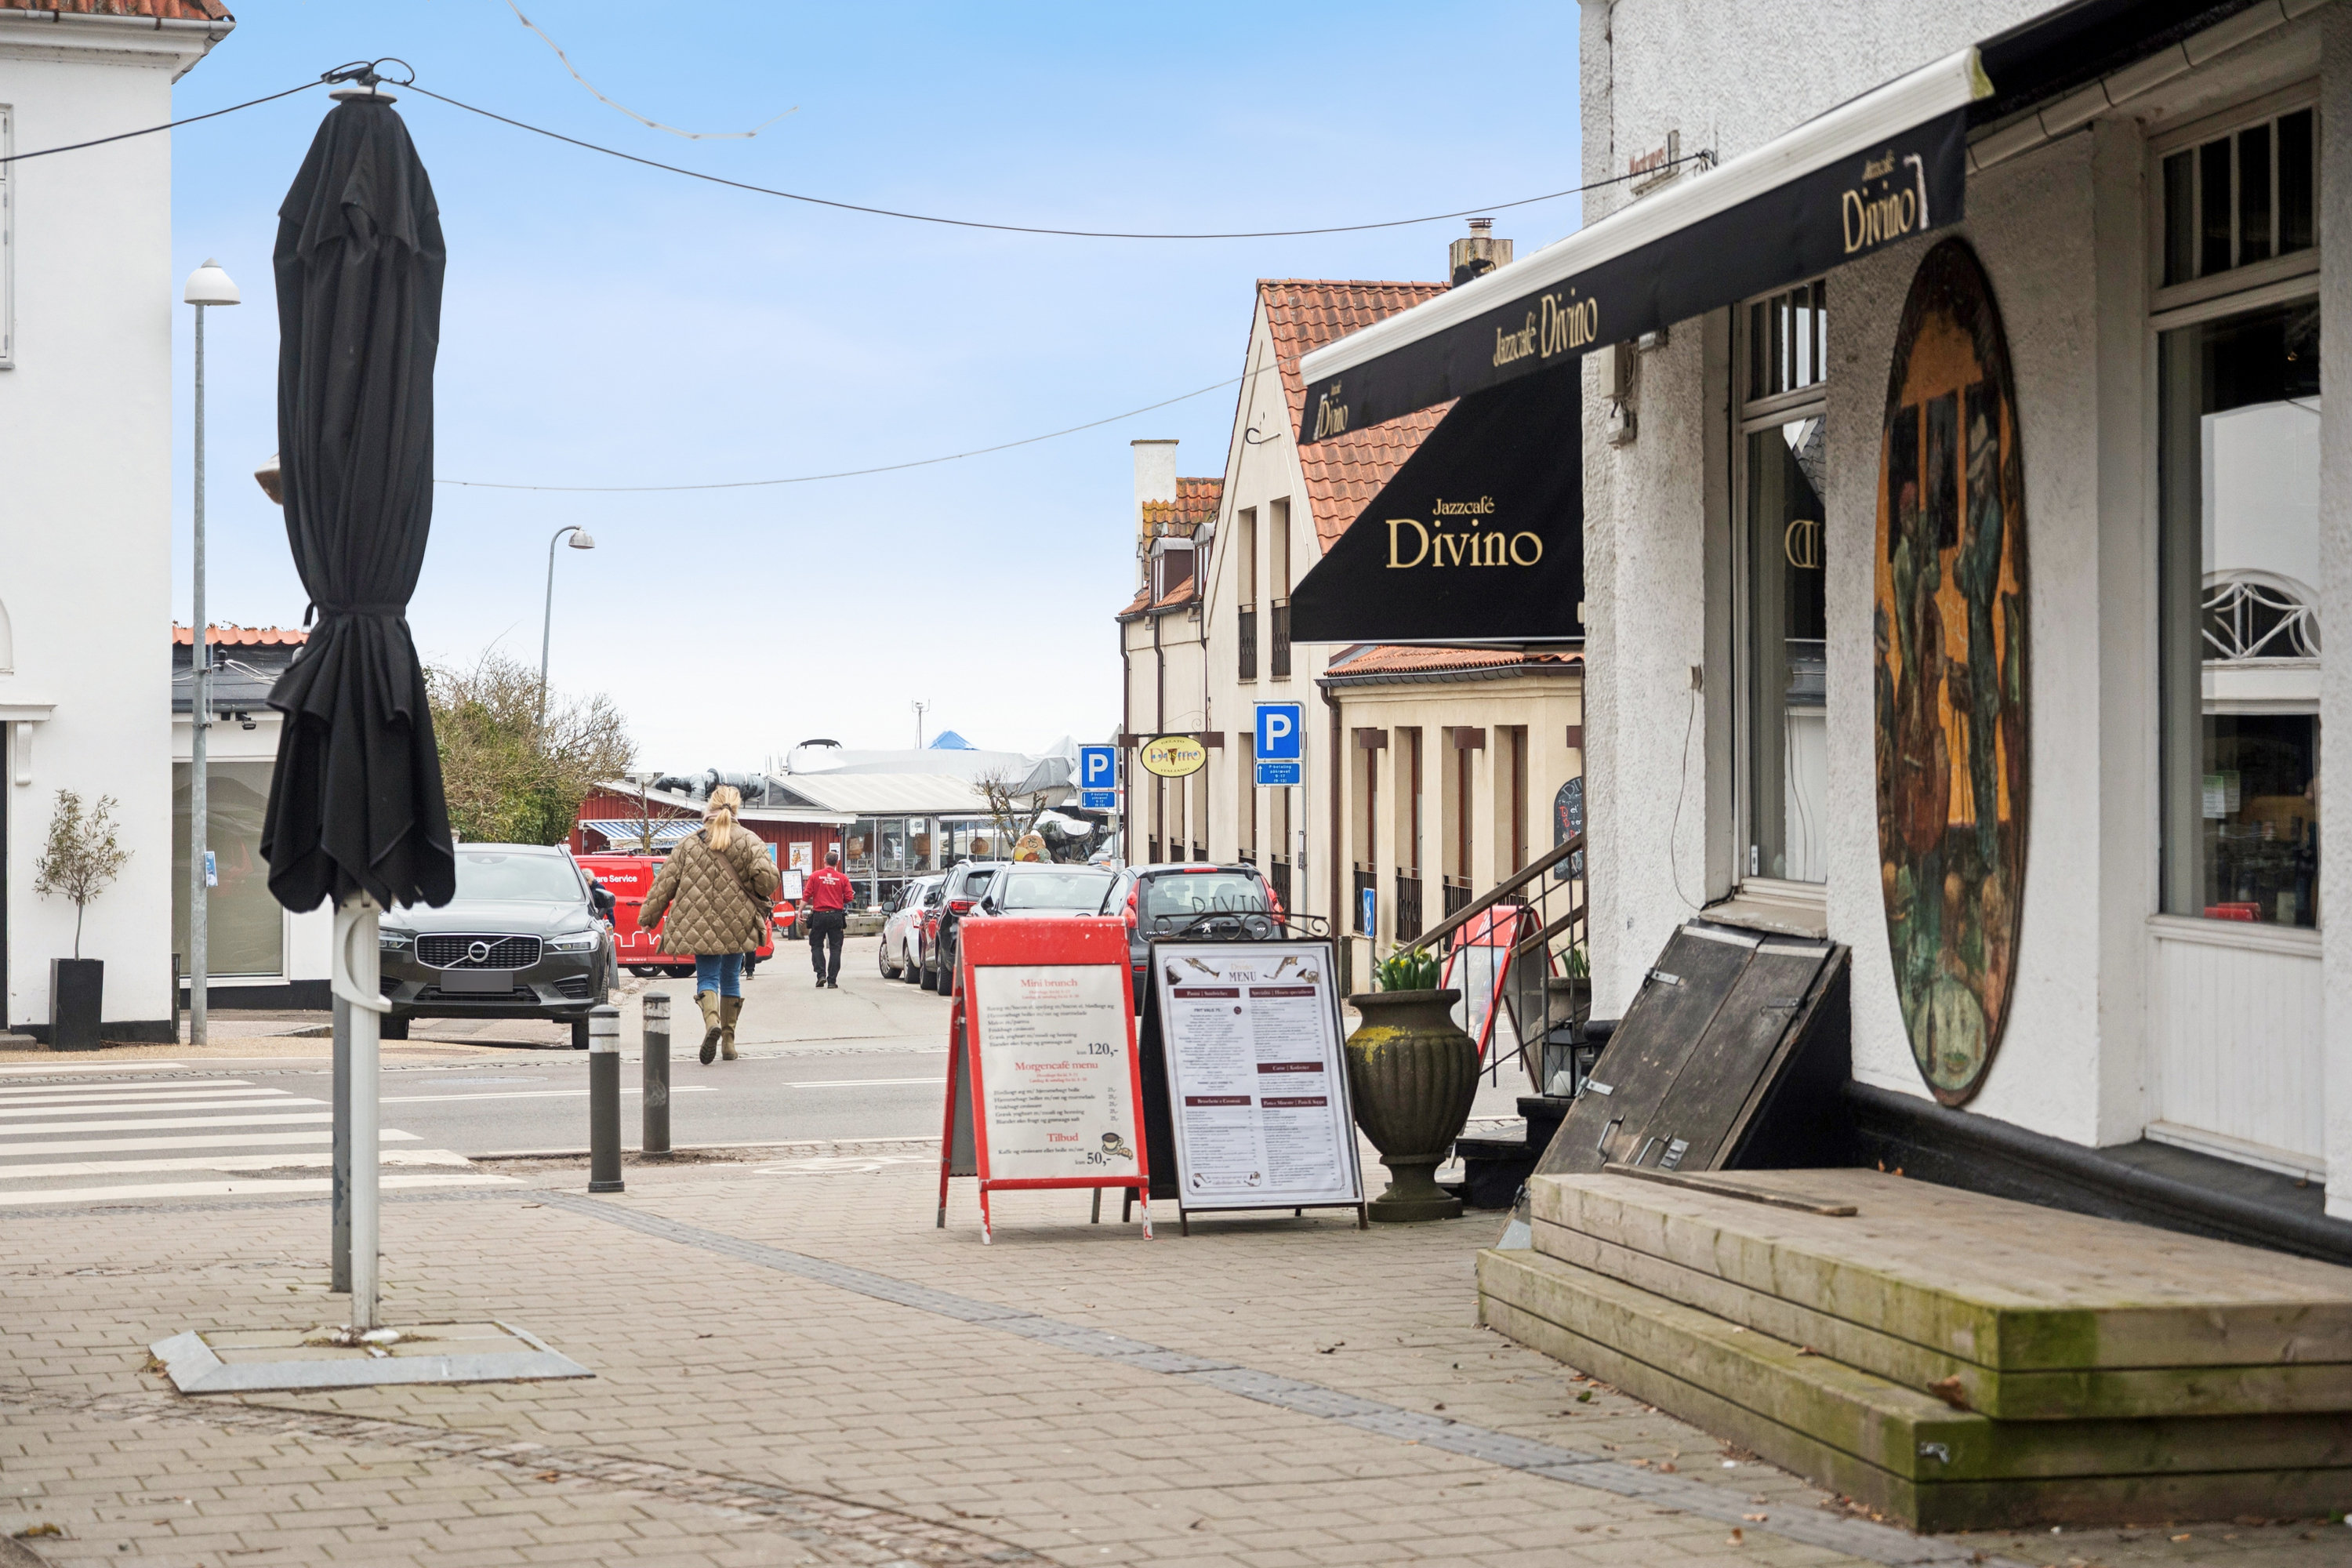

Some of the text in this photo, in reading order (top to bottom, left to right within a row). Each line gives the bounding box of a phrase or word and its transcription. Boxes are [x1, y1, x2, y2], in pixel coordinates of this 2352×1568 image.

[1843, 180, 1915, 253] Divino
[1541, 287, 1598, 358] Divino
[1432, 495, 1495, 515] Jazzcafé
[1385, 518, 1543, 569] Divino
[1266, 713, 1292, 751] P
[1088, 753, 1109, 782] P
[609, 874, 637, 883] Service
[1021, 978, 1078, 988] Mini brunch
[1229, 971, 1257, 982] MENU
[1087, 1043, 1119, 1057] 120,-
[1014, 1061, 1070, 1073] Morgencafé
[1047, 1133, 1079, 1142] Tilbud
[1087, 1152, 1112, 1167] 50,-
